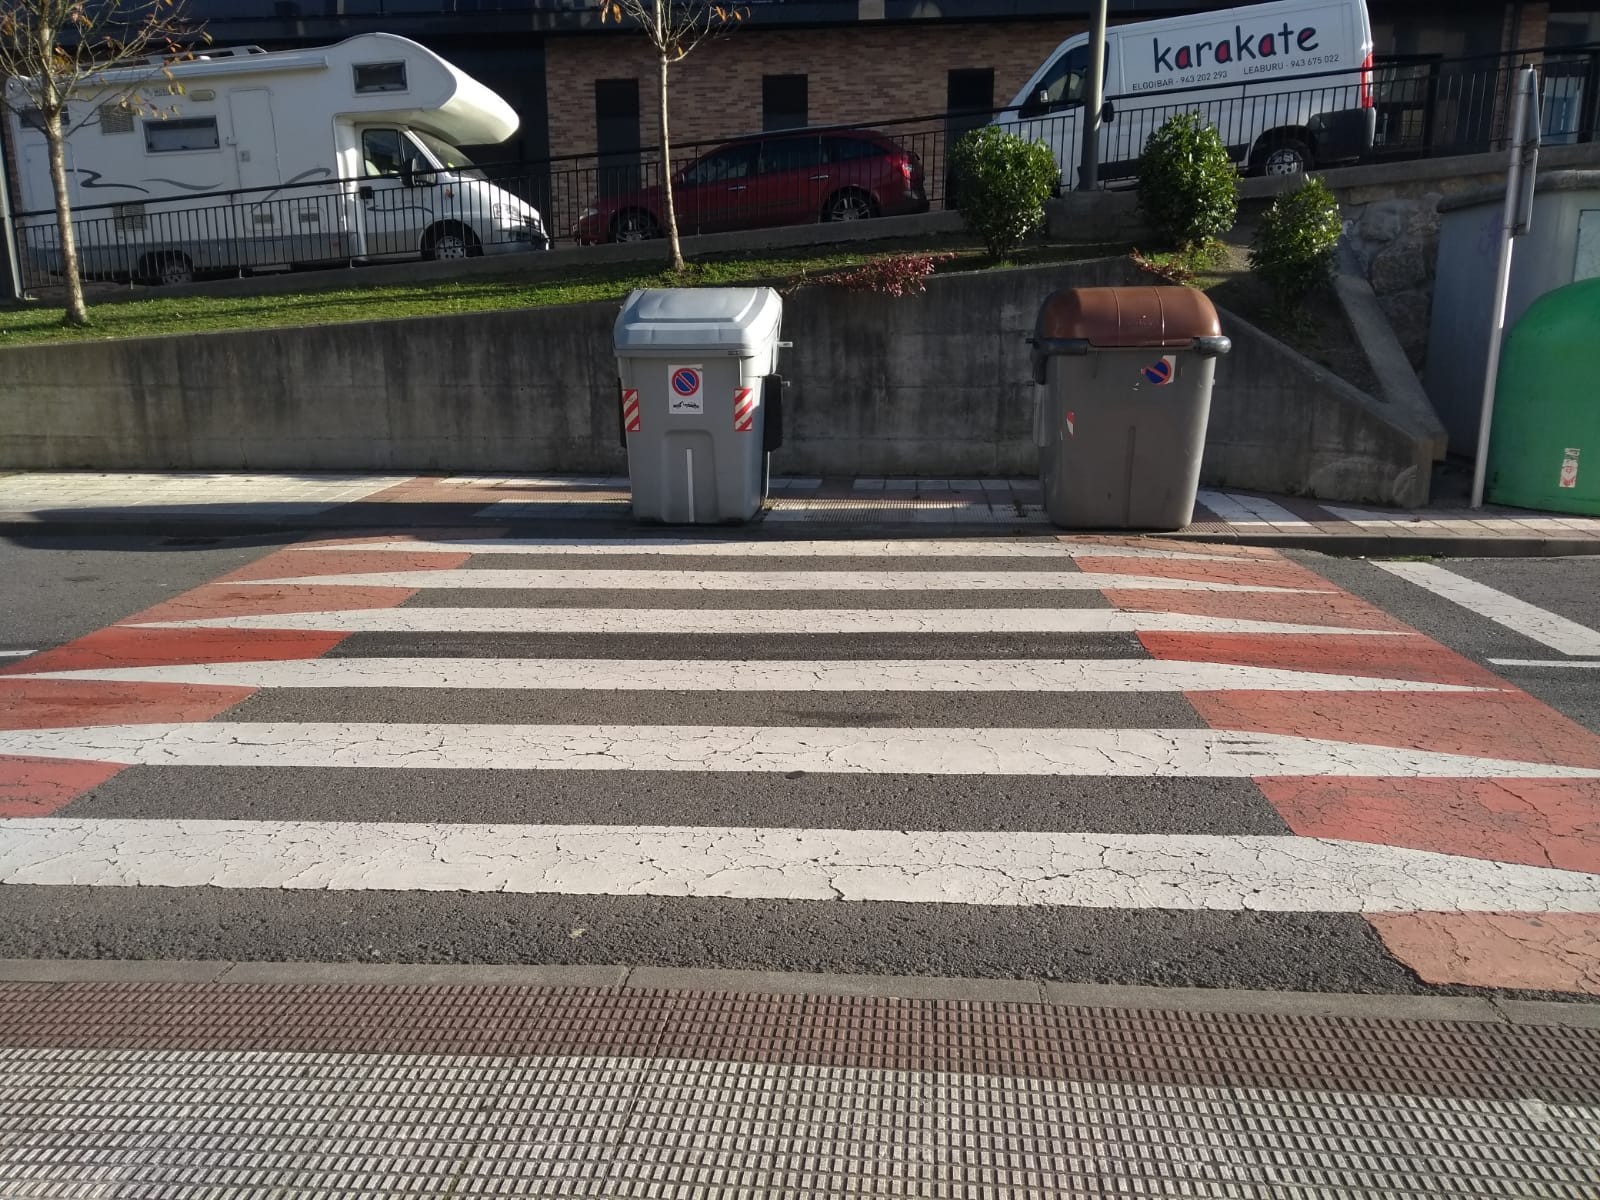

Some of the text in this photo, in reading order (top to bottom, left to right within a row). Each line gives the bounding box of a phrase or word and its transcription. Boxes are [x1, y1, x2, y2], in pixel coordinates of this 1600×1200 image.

[1153, 22, 1319, 73] karakate
[1243, 62, 1284, 75] LEABURU
[1290, 59, 1306, 68] 943
[1307, 57, 1322, 66] 675
[1132, 78, 1174, 91] ELGOIBAR
[1180, 75, 1195, 83] 943
[1197, 73, 1212, 82] 202
[1213, 70, 1228, 80] 293
